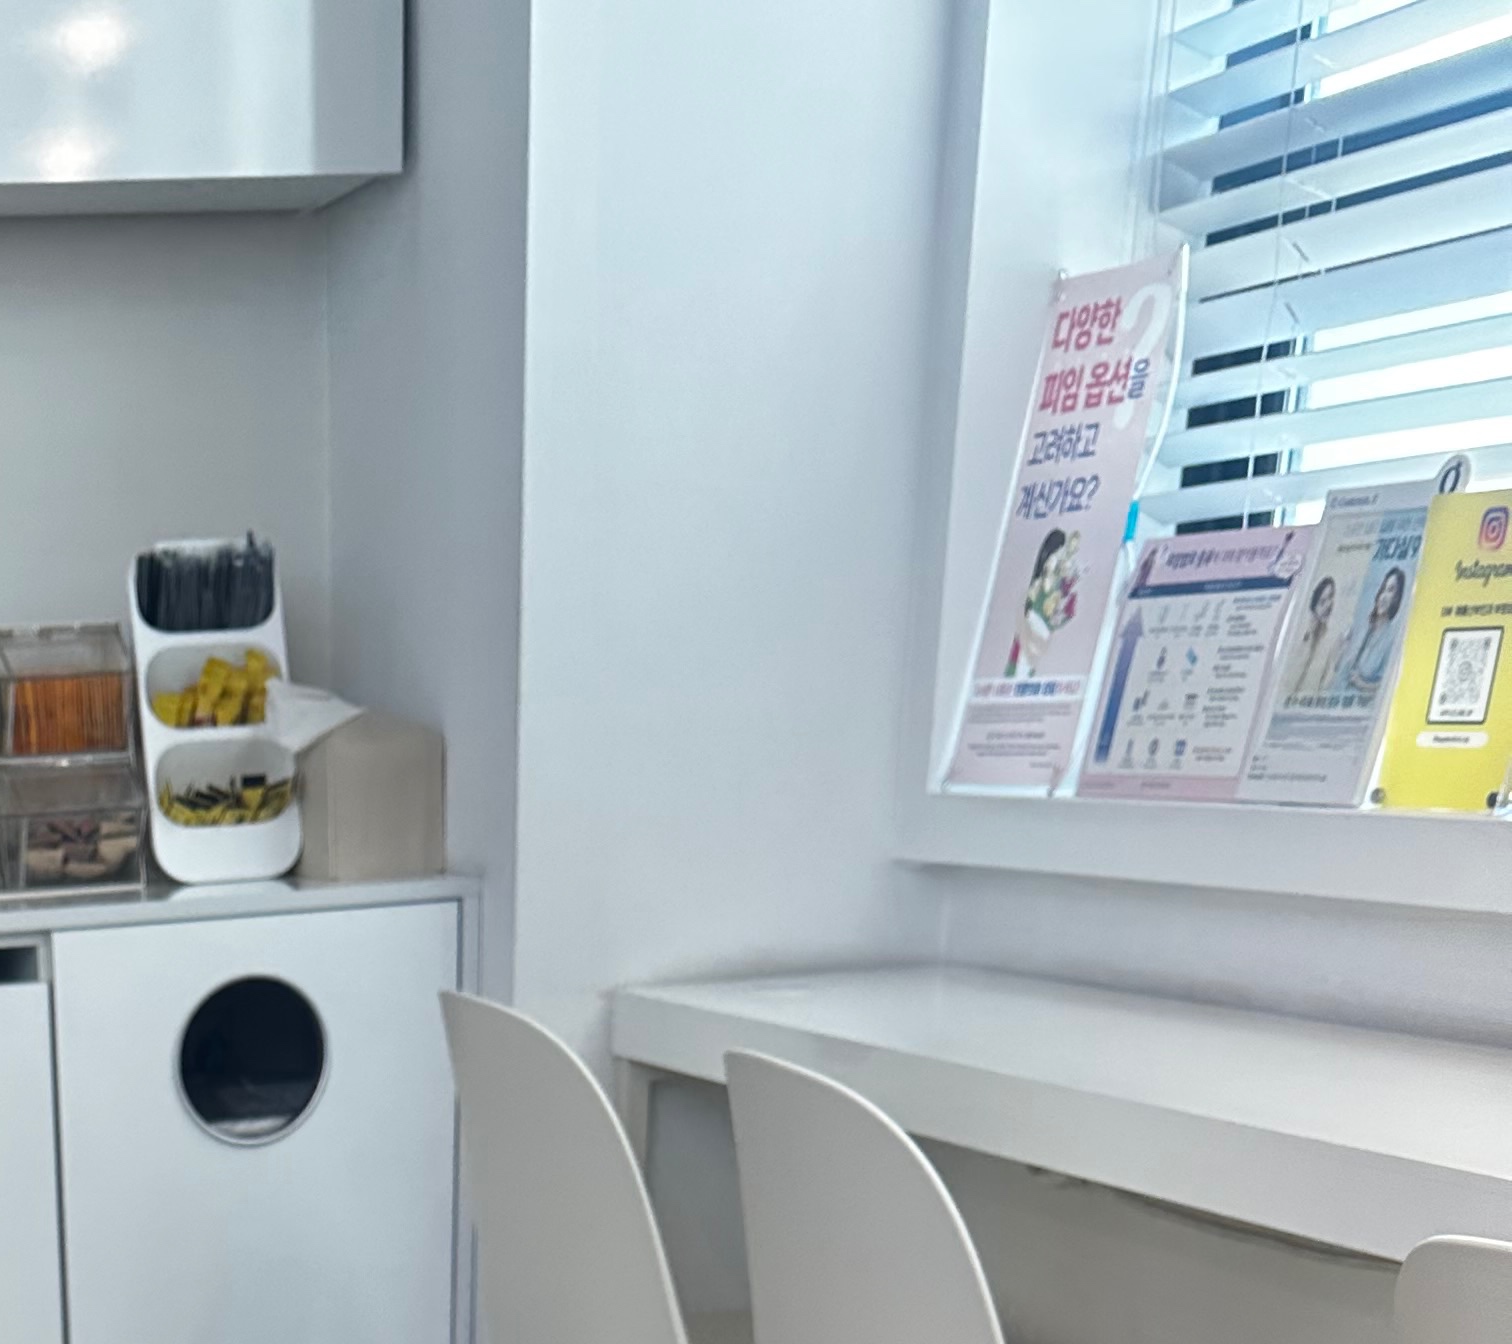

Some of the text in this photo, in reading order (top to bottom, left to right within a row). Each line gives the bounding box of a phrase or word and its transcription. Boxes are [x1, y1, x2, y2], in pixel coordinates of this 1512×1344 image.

[1052, 296, 1122, 352] 다양한
[1039, 355, 1150, 415] 피임 옵션을
[1027, 422, 1101, 466] 고려하고
[1016, 474, 1101, 519] 계신가요?
